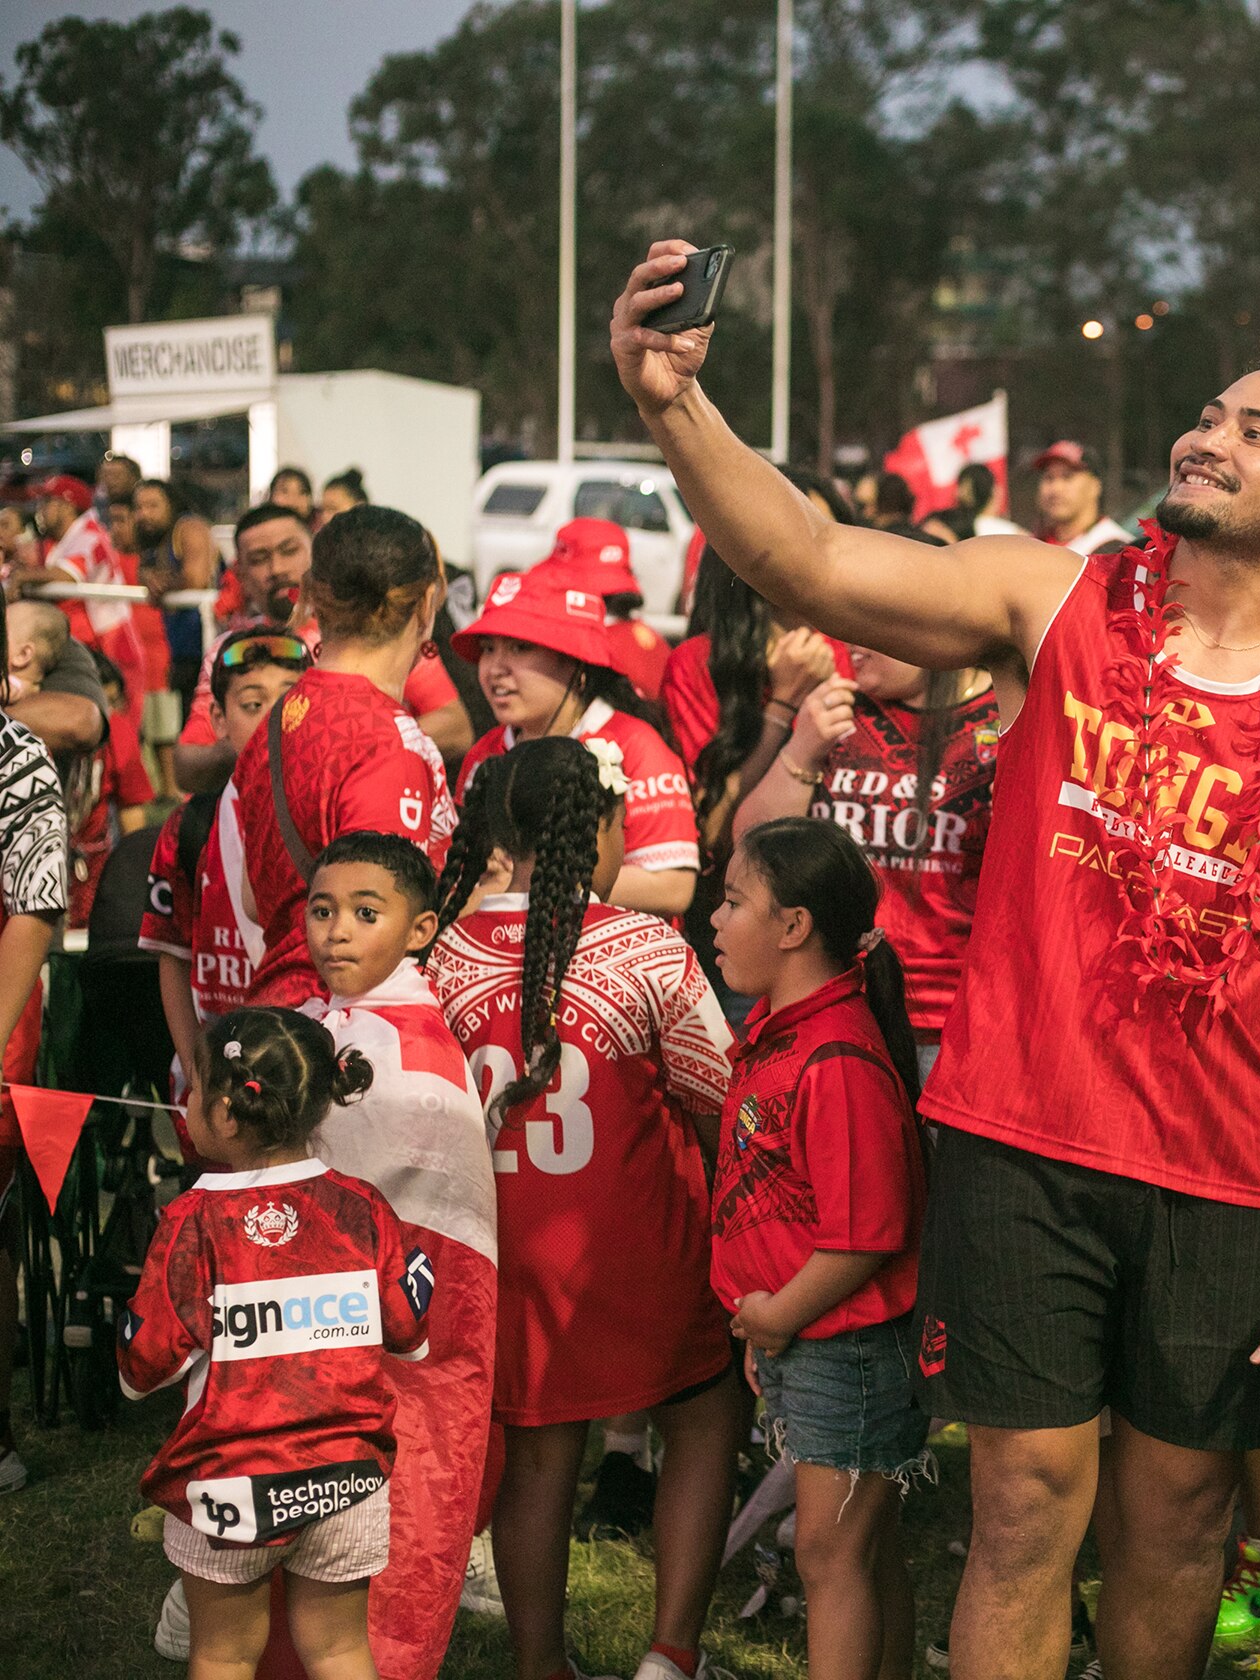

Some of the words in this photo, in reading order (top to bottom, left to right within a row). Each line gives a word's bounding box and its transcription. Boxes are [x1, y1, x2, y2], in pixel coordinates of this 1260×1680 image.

[114, 334, 261, 380] MERCHANDISE
[581, 1022, 618, 1062] CUP
[469, 1042, 594, 1175] 23
[212, 1291, 369, 1349] signace
[309, 1324, 370, 1341] .com.au
[267, 1473, 384, 1506] technology
[272, 1493, 351, 1527] people
[200, 1491, 240, 1537] tp
